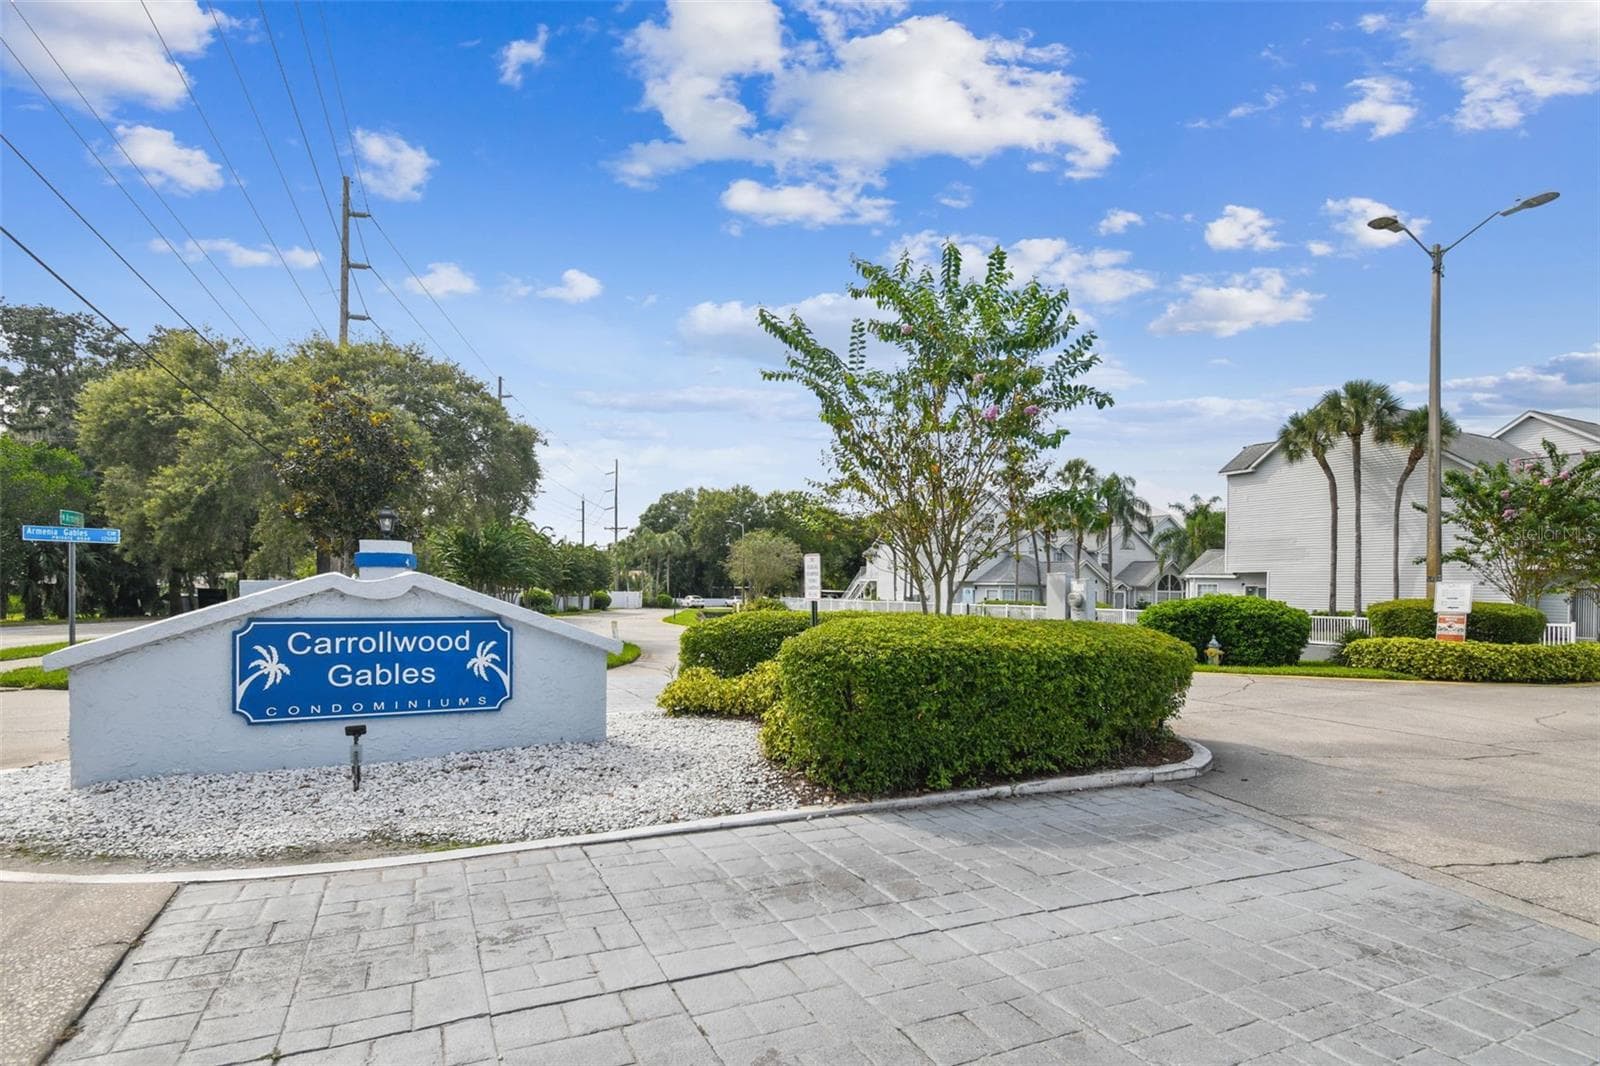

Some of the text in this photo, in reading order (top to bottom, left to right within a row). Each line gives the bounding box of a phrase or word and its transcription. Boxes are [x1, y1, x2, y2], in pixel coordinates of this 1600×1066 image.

[26, 527, 58, 536] Armenia
[63, 528, 88, 537] Gables
[287, 630, 470, 655] Carrollwood
[327, 663, 436, 687] Gables
[265, 696, 487, 717] CONDOMINIUMS
